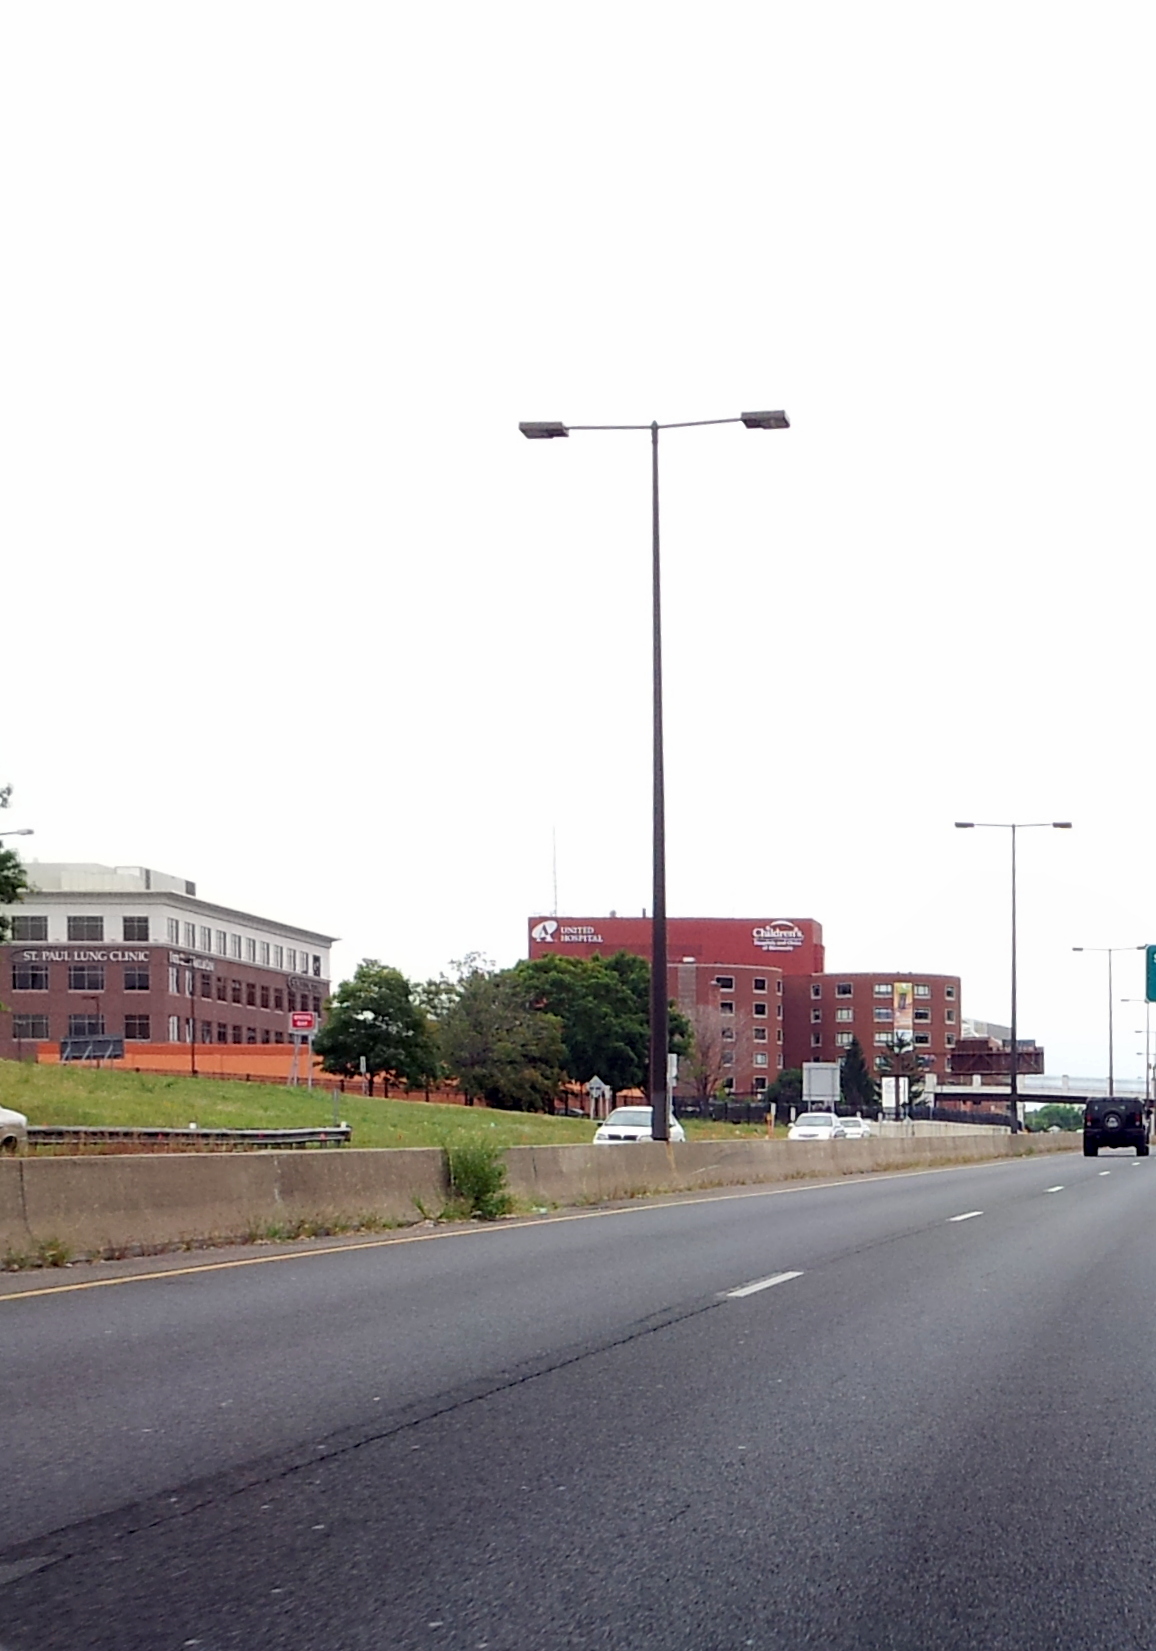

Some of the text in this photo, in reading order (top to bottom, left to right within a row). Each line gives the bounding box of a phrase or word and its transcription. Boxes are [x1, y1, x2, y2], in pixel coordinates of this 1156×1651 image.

[560, 926, 594, 934] UNITED
[752, 925, 803, 938] Children's
[560, 935, 603, 943] HOSPITAL
[23, 951, 150, 961] ST. PAUL LUNG CLINIC
